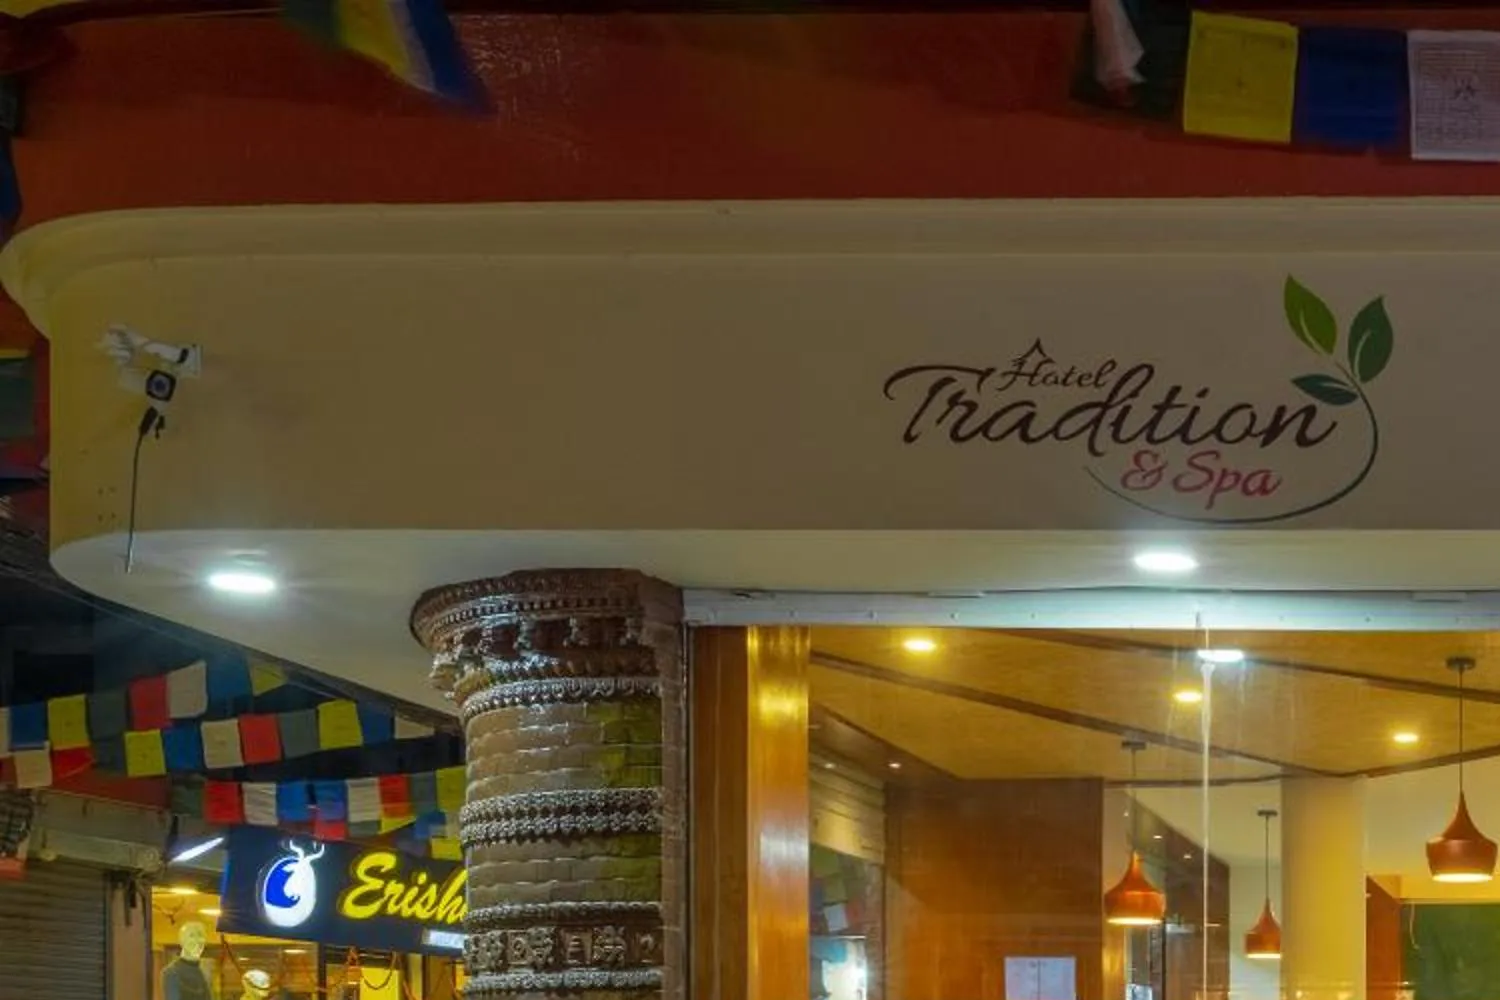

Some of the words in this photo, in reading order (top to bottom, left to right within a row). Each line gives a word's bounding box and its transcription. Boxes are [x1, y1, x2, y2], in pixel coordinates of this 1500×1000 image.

[883, 362, 1338, 457] Tradition
[1120, 449, 1169, 492] &
[1172, 450, 1282, 510] Spa
[343, 851, 469, 925] Erish
